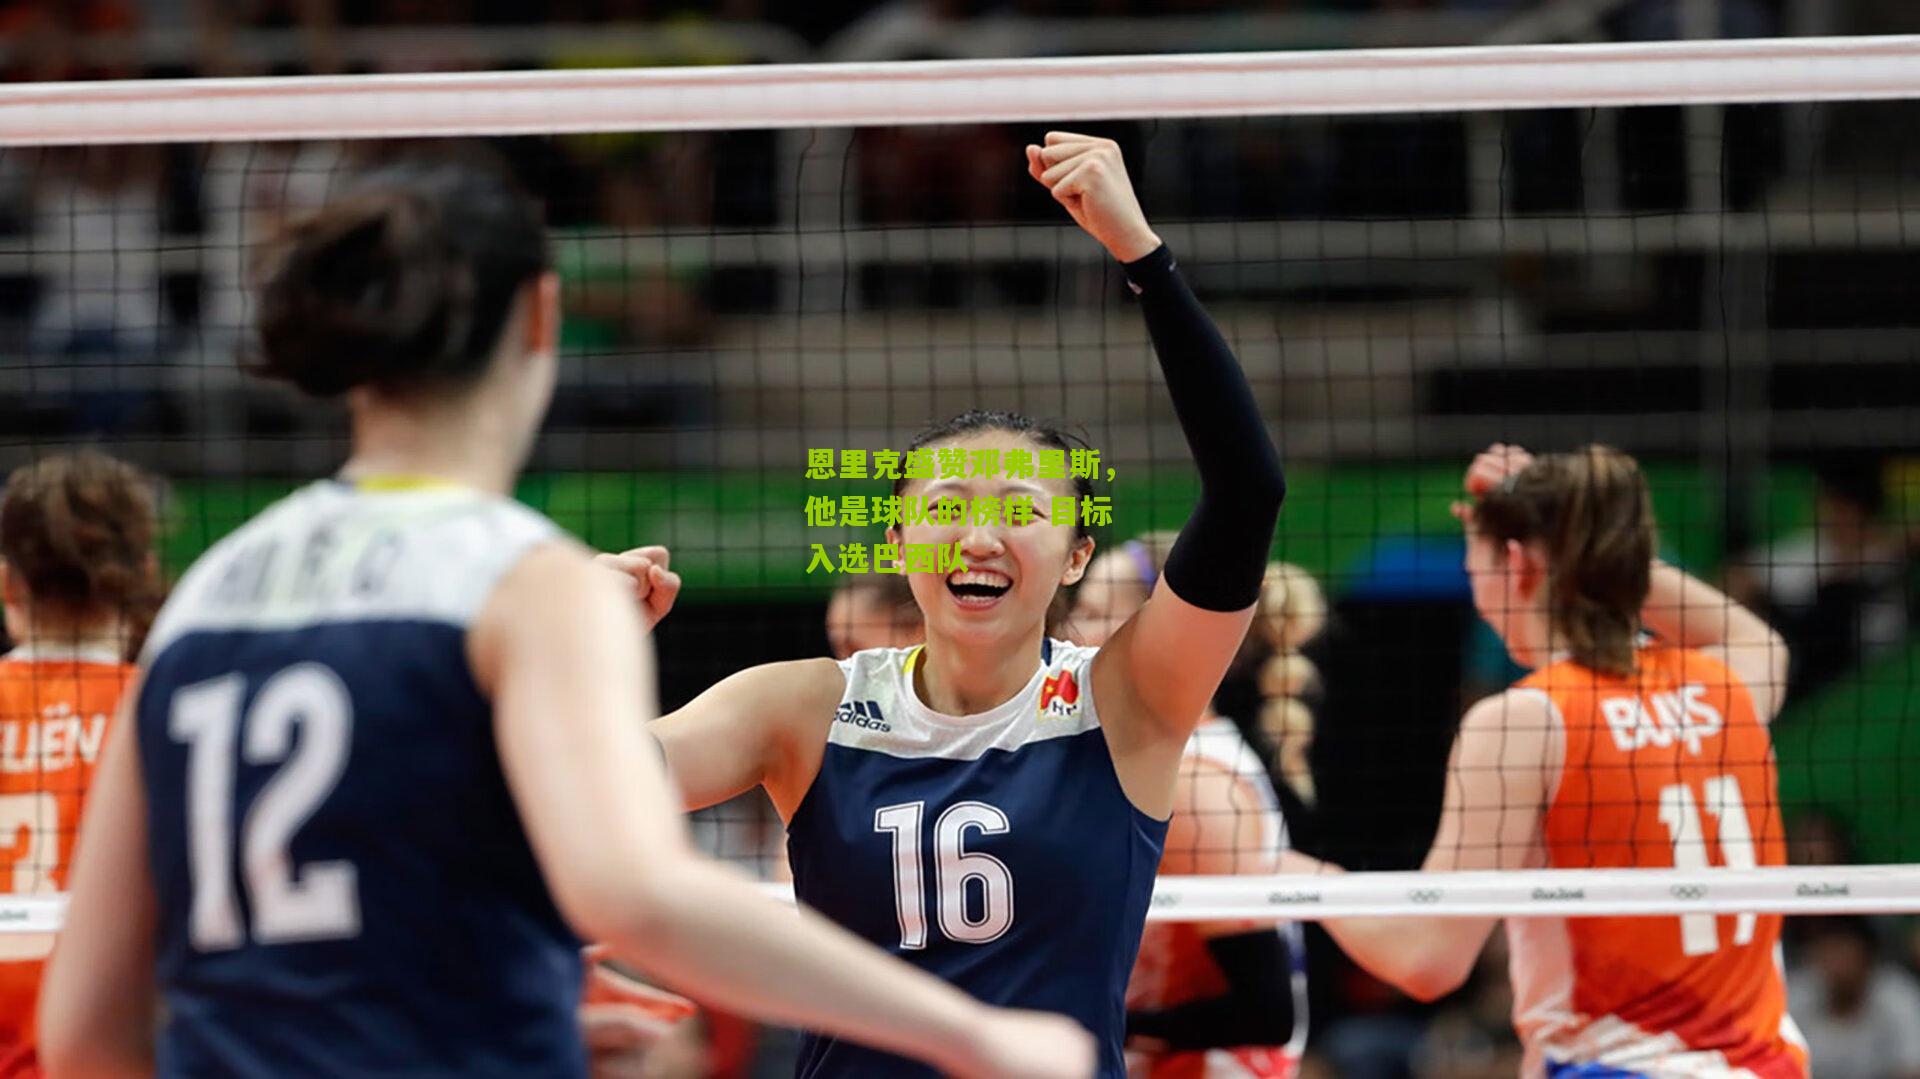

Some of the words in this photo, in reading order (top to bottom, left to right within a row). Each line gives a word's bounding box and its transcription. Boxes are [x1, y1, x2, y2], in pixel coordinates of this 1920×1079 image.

[168, 661, 362, 953] 12
[873, 800, 1014, 950] 16
[1657, 774, 1758, 957] 11
